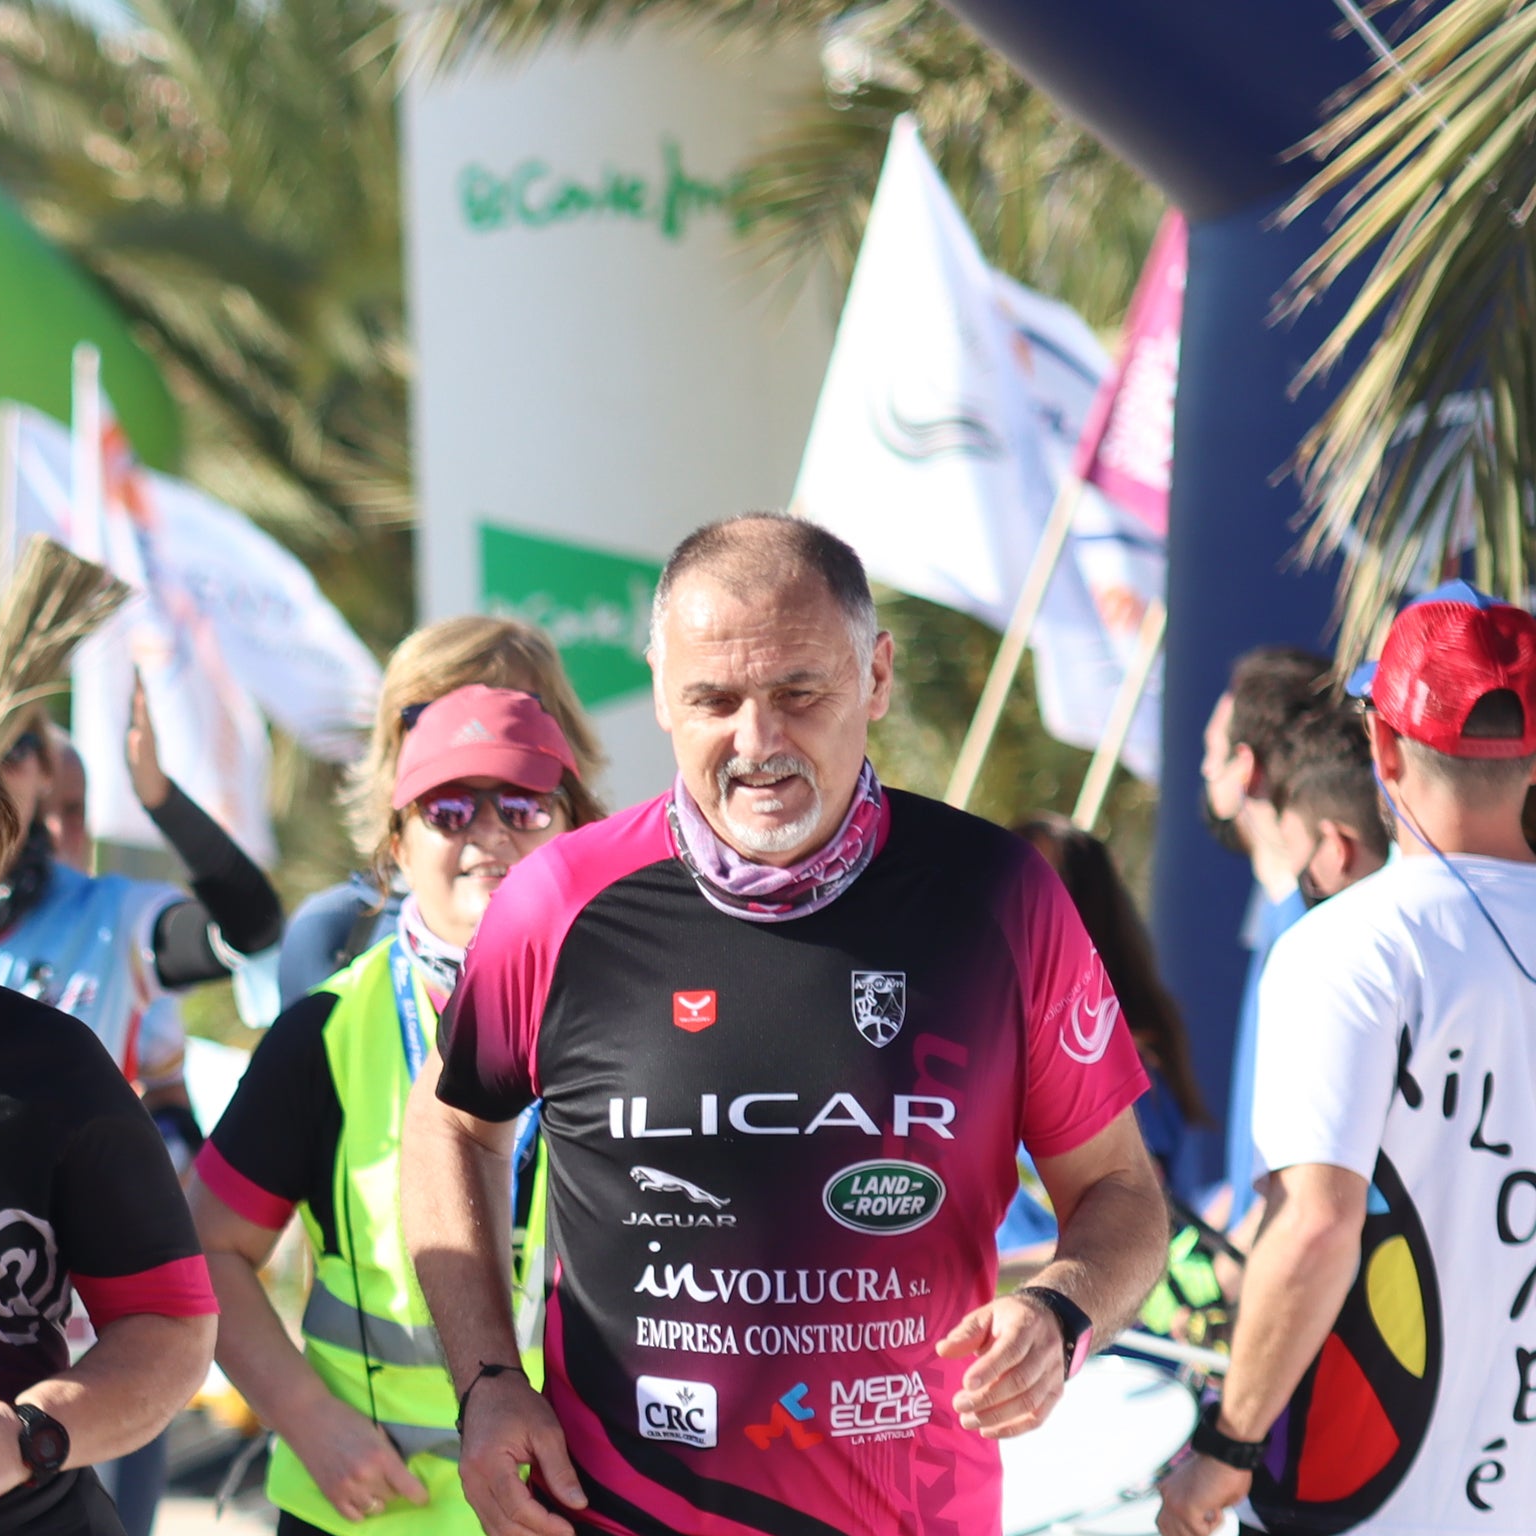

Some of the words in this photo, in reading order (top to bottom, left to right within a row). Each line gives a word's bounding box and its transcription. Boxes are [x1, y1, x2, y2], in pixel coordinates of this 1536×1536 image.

[609, 1092, 956, 1140] ILICAR
[850, 1175, 911, 1195] LAND
[622, 1211, 738, 1228] JAGUAR
[855, 1196, 926, 1217] ROVER
[636, 1316, 740, 1356] EMPRESA
[744, 1315, 927, 1357] CONSTRUCTORA
[831, 1370, 927, 1406] MEDIA
[645, 1401, 706, 1435] CRC
[831, 1394, 933, 1429] ELCHE
